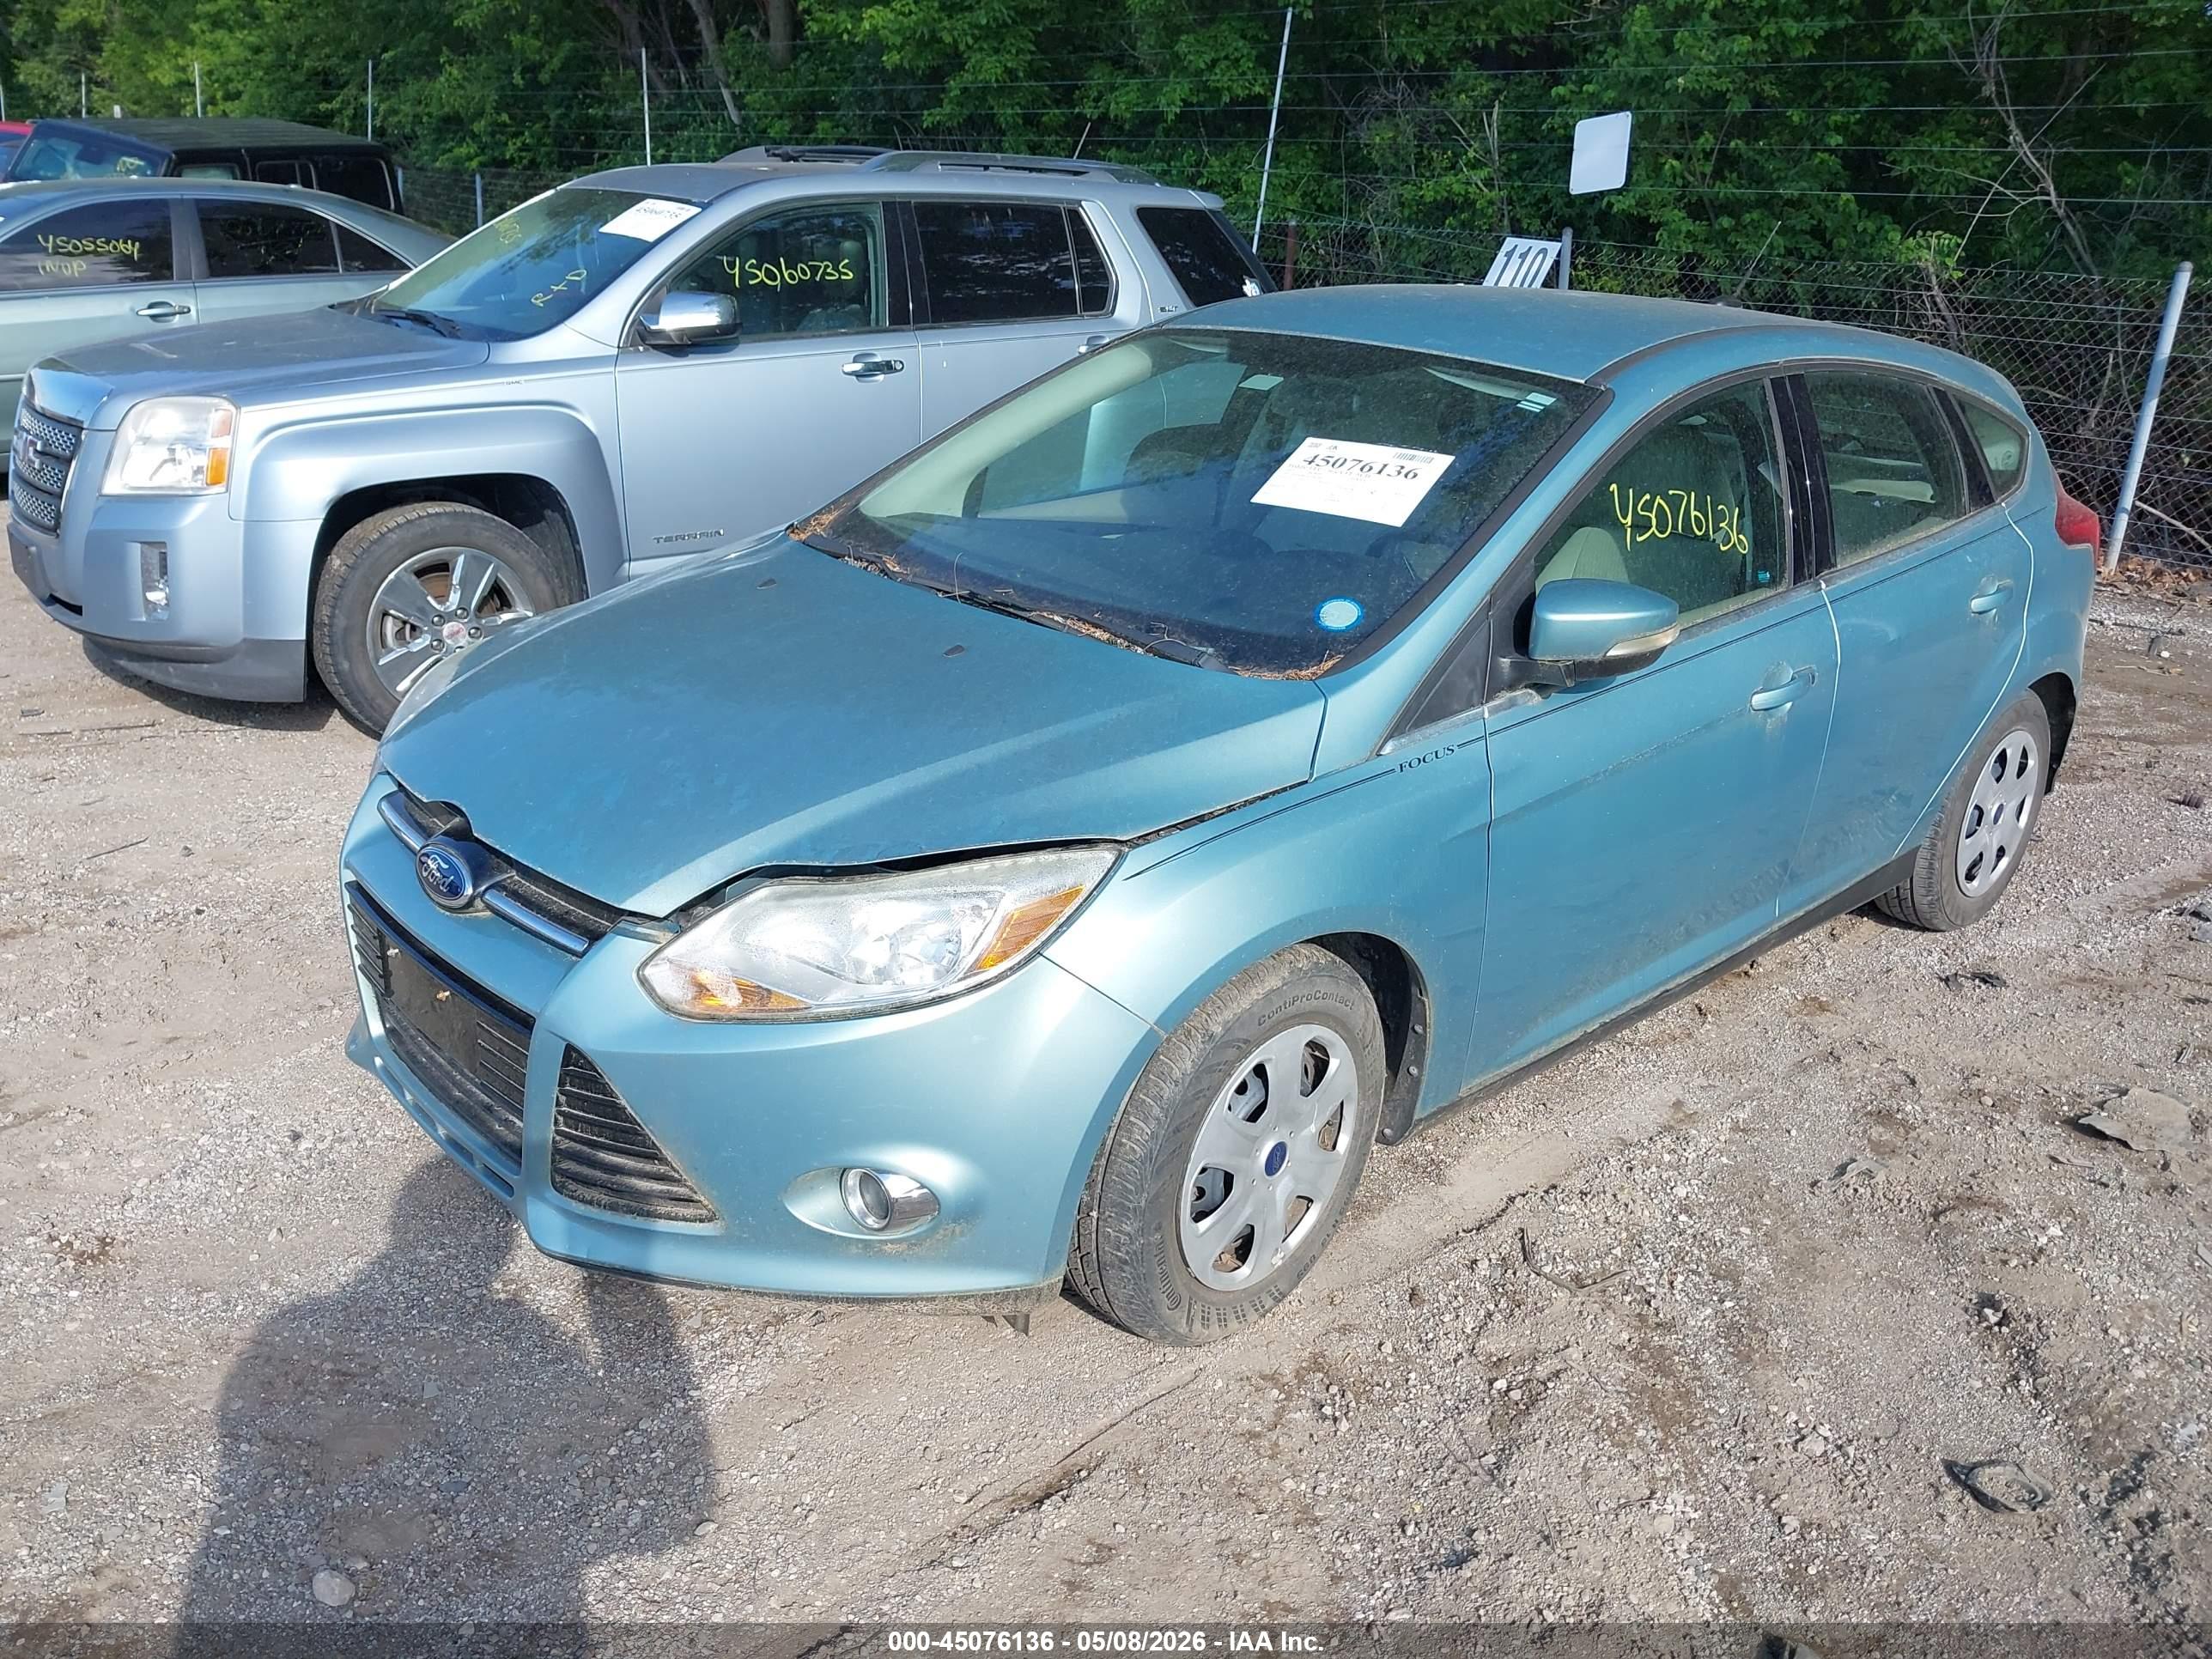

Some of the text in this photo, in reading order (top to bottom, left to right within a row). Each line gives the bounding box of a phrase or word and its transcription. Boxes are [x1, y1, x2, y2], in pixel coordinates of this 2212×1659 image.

[723, 256, 854, 292] 45060735
[1494, 244, 1548, 288] 110
[1303, 453, 1423, 480] 45076136
[653, 529, 724, 544] TERRAIN
[1610, 483, 1748, 554] 45076136
[1399, 744, 1455, 773] FOCUS
[420, 854, 453, 892] Ford
[1257, 989, 1354, 1027] ContiProContact
